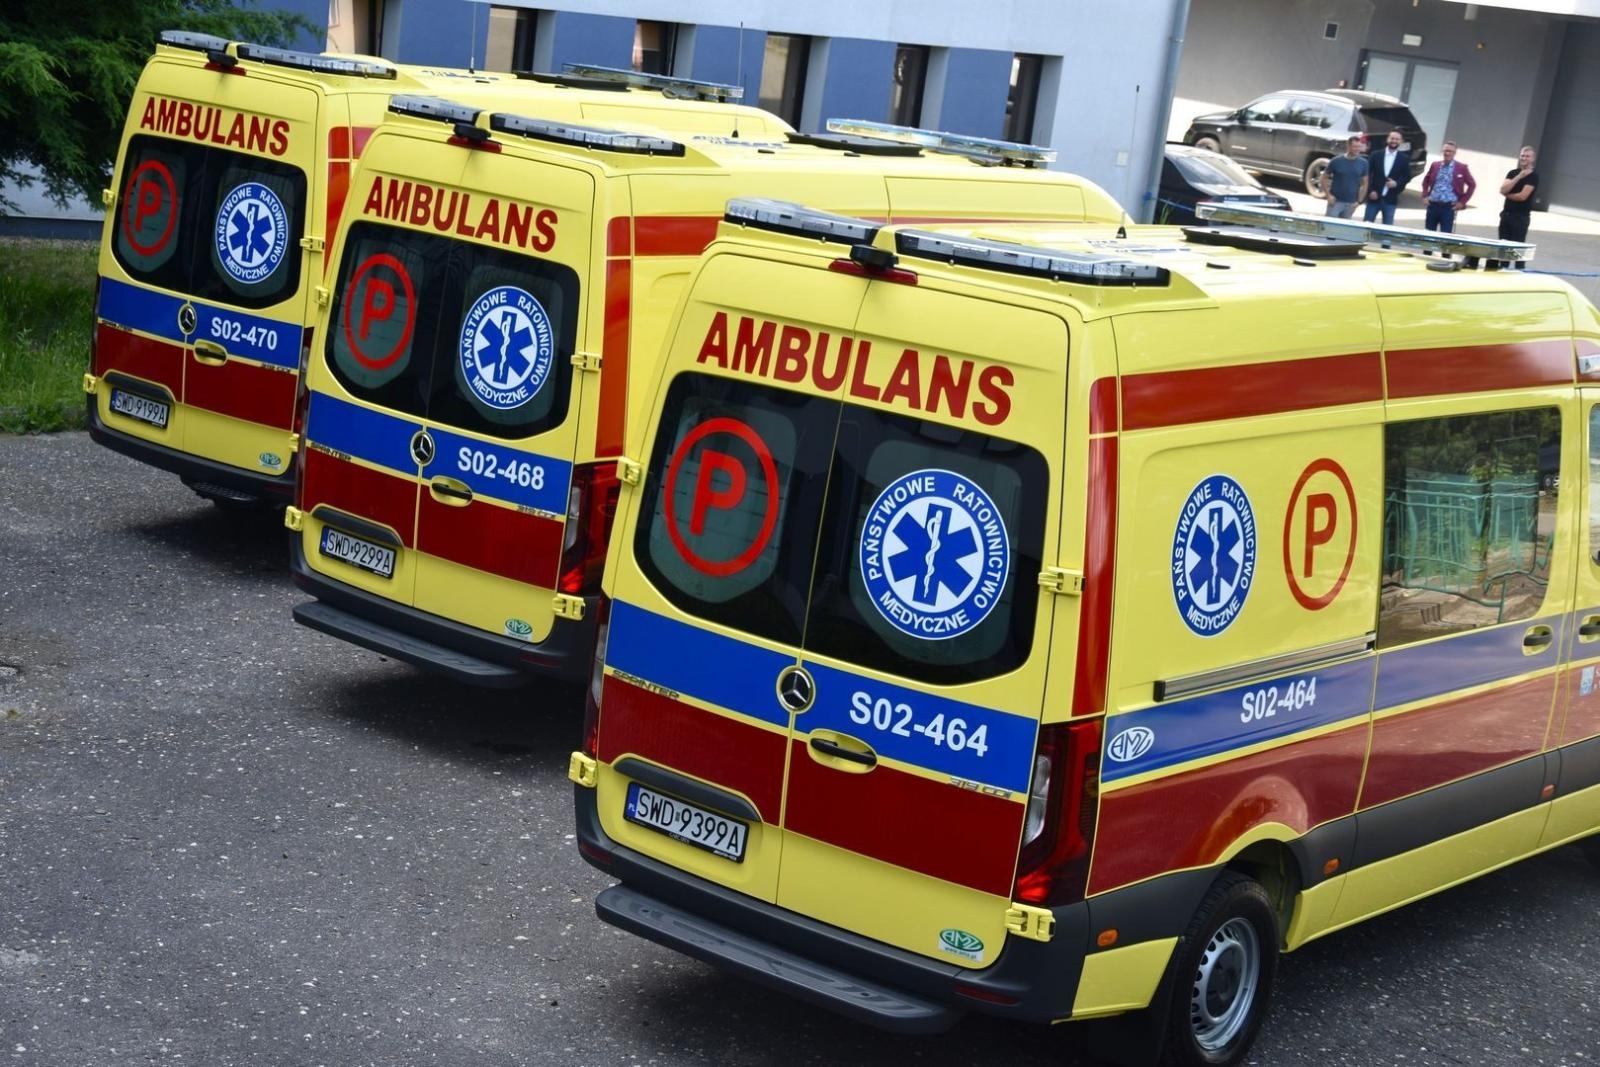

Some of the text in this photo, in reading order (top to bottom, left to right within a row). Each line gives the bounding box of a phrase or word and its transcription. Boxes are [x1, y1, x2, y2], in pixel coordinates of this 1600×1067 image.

[141, 96, 290, 156] AMBULANS
[136, 182, 161, 231] P
[260, 190, 286, 263] RATOWNICTWO
[364, 175, 558, 253] AMBULANS
[225, 256, 270, 280] MEDYCZNE
[211, 316, 278, 350] S02-470
[359, 278, 396, 341] P
[462, 291, 549, 385] PAŃSTWOWE RATOWNICTWO
[472, 375, 529, 404] MEDYCZNE
[696, 311, 1015, 426] AMBULANS
[457, 446, 545, 490] S02-468
[689, 448, 748, 536] P
[327, 532, 390, 572] SWD 9299A
[864, 476, 1003, 609] PAŃSTWOWE RATOWNICTWO
[1172, 482, 1254, 601] PAŃSTWOWE RATOWNICTWO
[1304, 493, 1337, 579] P
[880, 591, 970, 633] MEDYCZNE
[1186, 595, 1240, 630] MEDYCZNE
[849, 691, 988, 757] S02-464
[1240, 676, 1317, 724] S02-464
[637, 792, 739, 854] SWD 9399A
